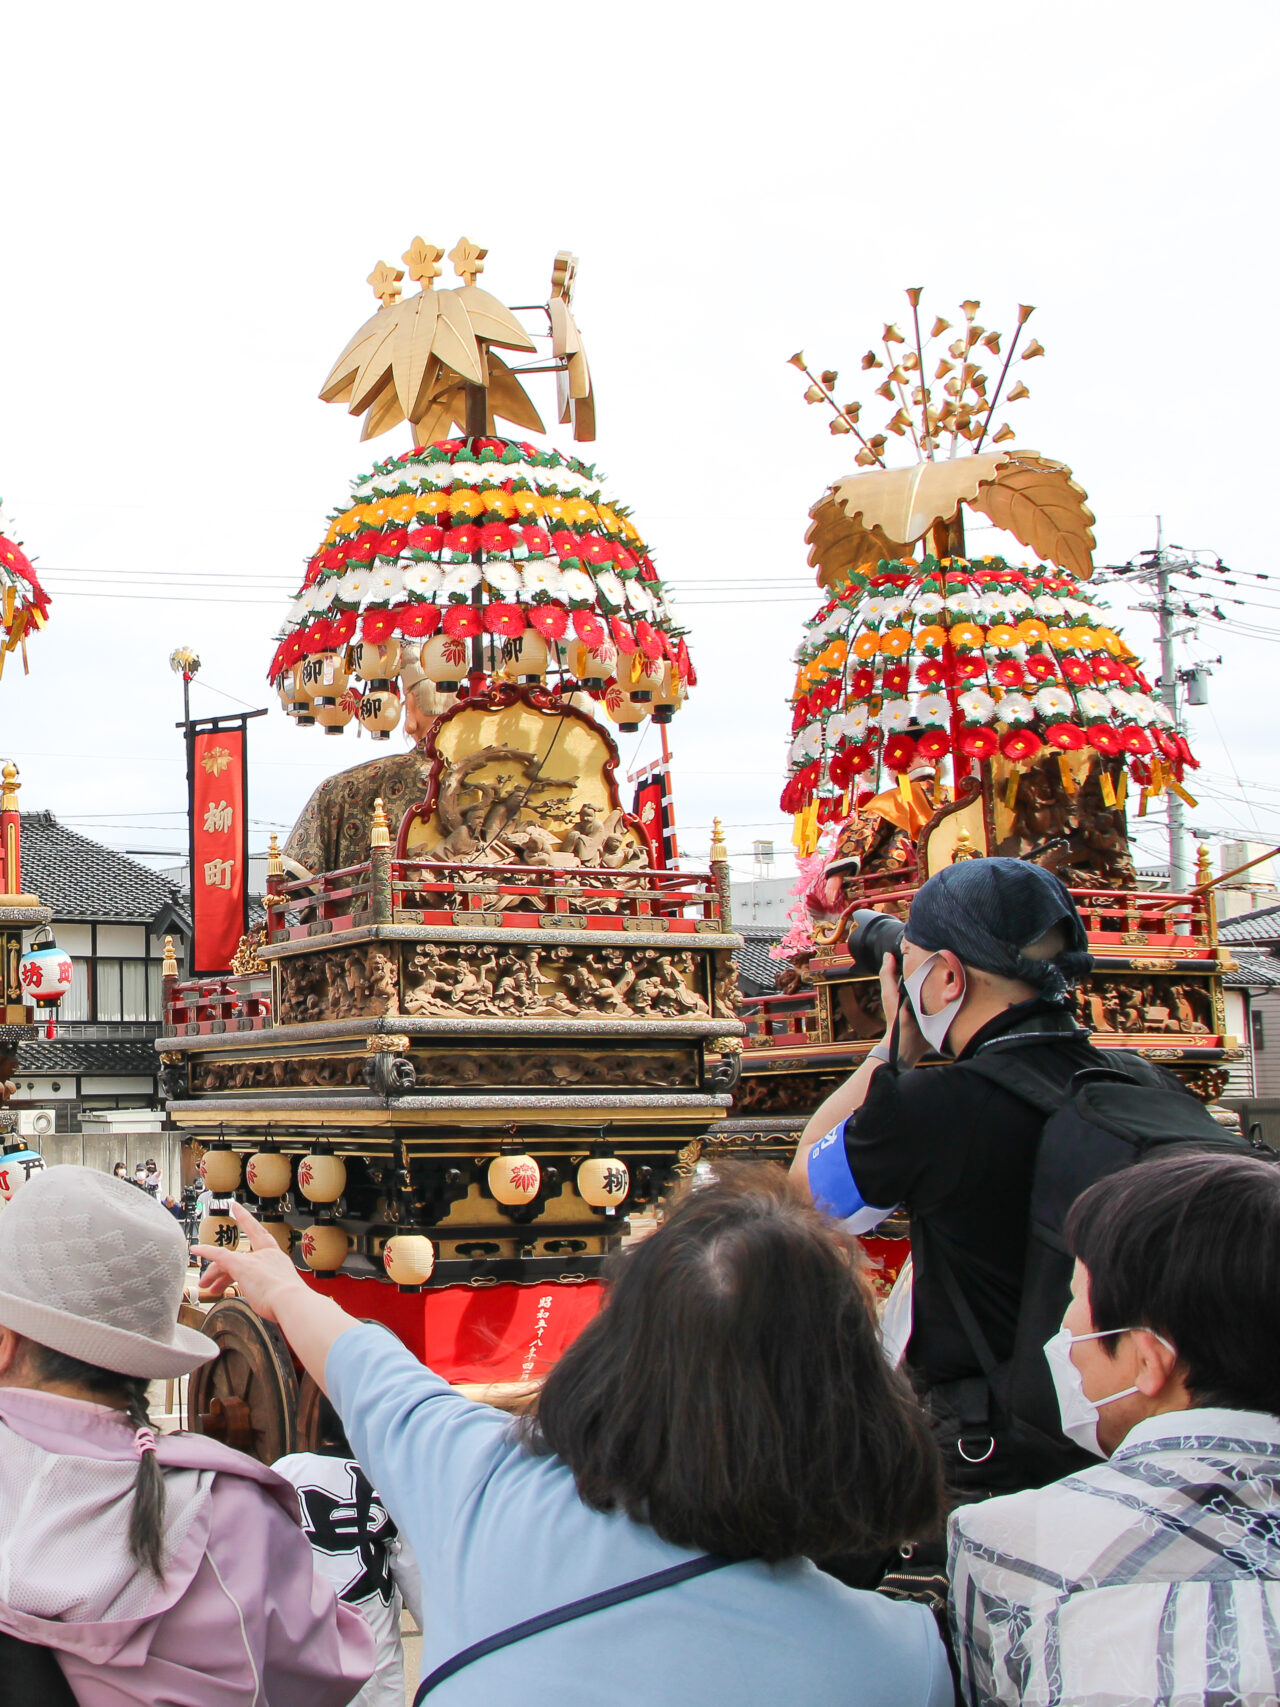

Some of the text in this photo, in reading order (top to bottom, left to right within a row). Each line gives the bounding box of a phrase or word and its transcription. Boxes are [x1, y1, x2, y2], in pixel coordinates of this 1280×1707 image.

[302, 659, 323, 686] 柳
[360, 697, 382, 719] 柳
[202, 800, 235, 890] 柳町
[602, 1167, 628, 1195] 柳
[214, 1223, 238, 1247] 柳
